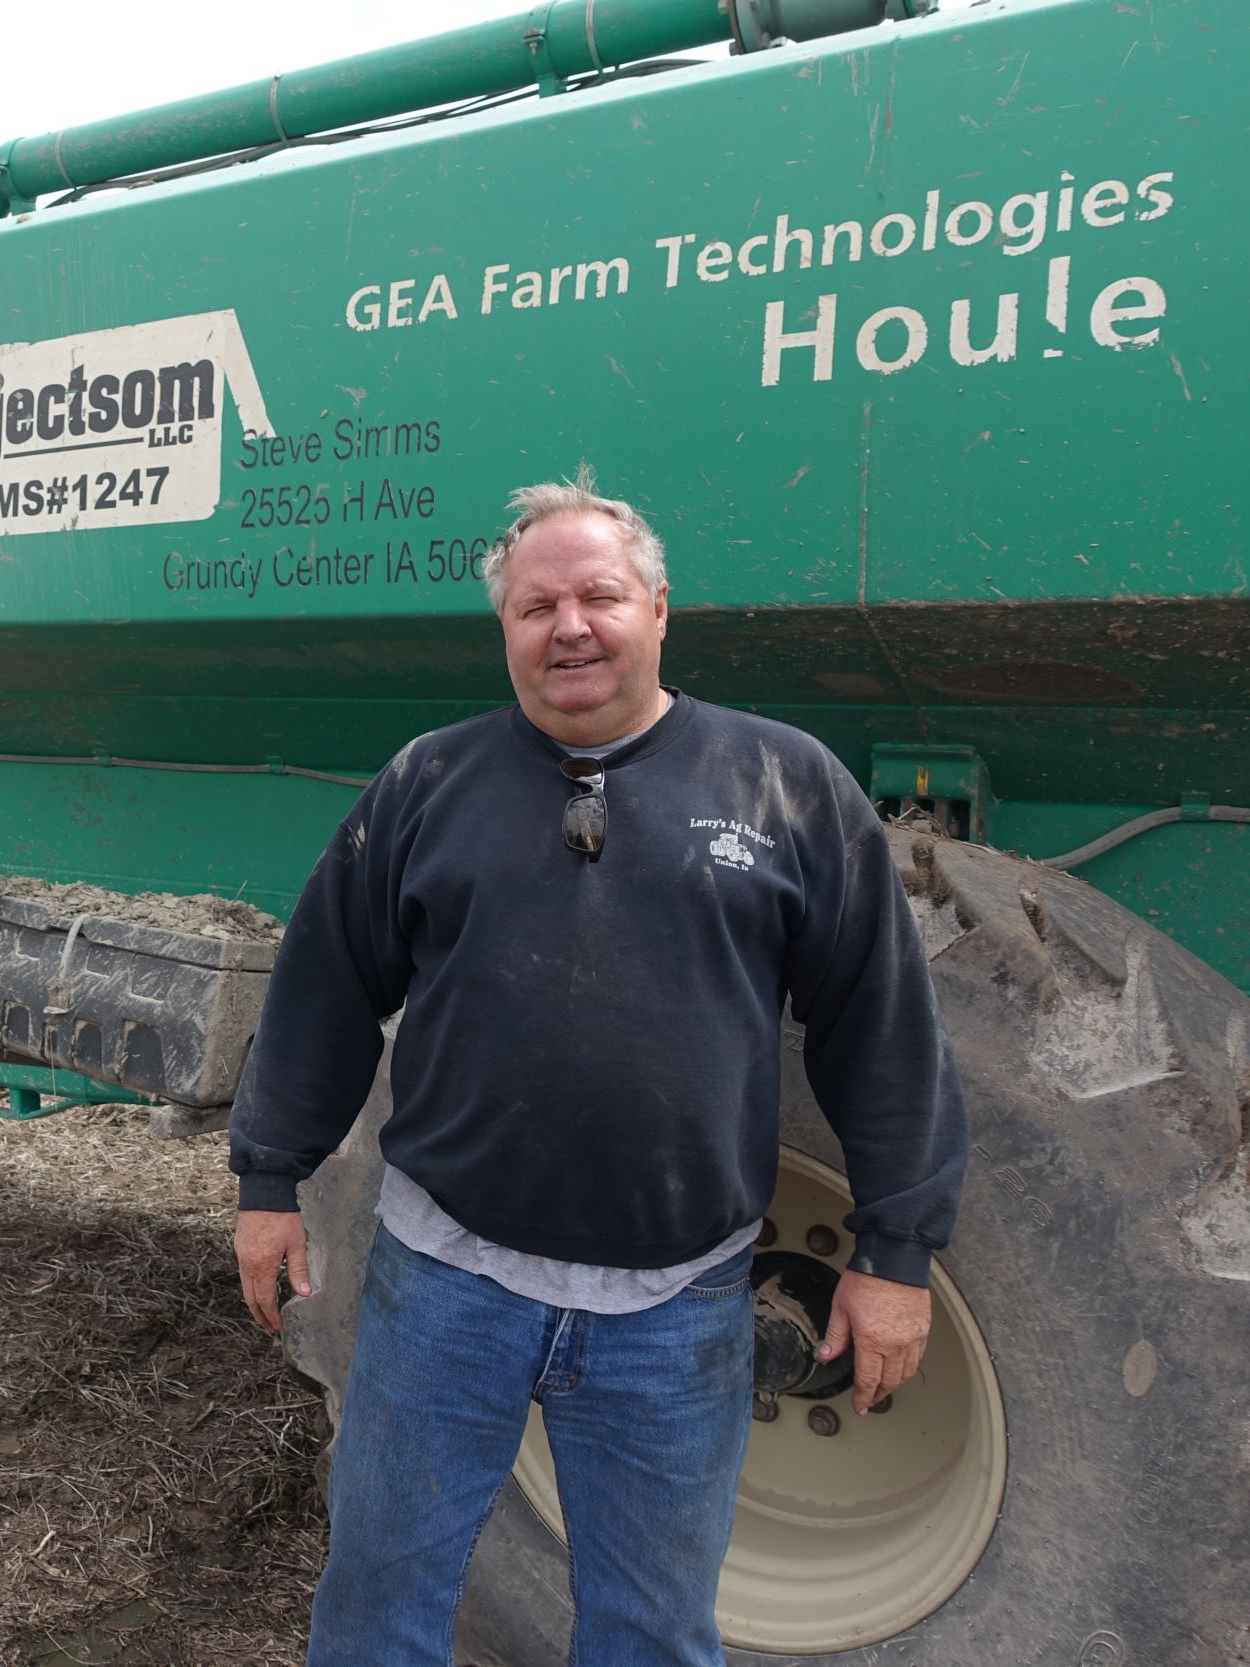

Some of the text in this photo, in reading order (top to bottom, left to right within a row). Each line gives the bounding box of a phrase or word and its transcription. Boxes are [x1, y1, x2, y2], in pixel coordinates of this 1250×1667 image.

[345, 171, 1174, 332] GEA Farm Technologies
[761, 255, 1167, 387] Houle
[148, 424, 193, 448] LLC
[240, 417, 441, 469] Steve Simms
[240, 477, 435, 529] 25525 H Ave
[163, 535, 496, 599] Grundy Center IA 506
[690, 818, 776, 848] Larry's Ag Repair
